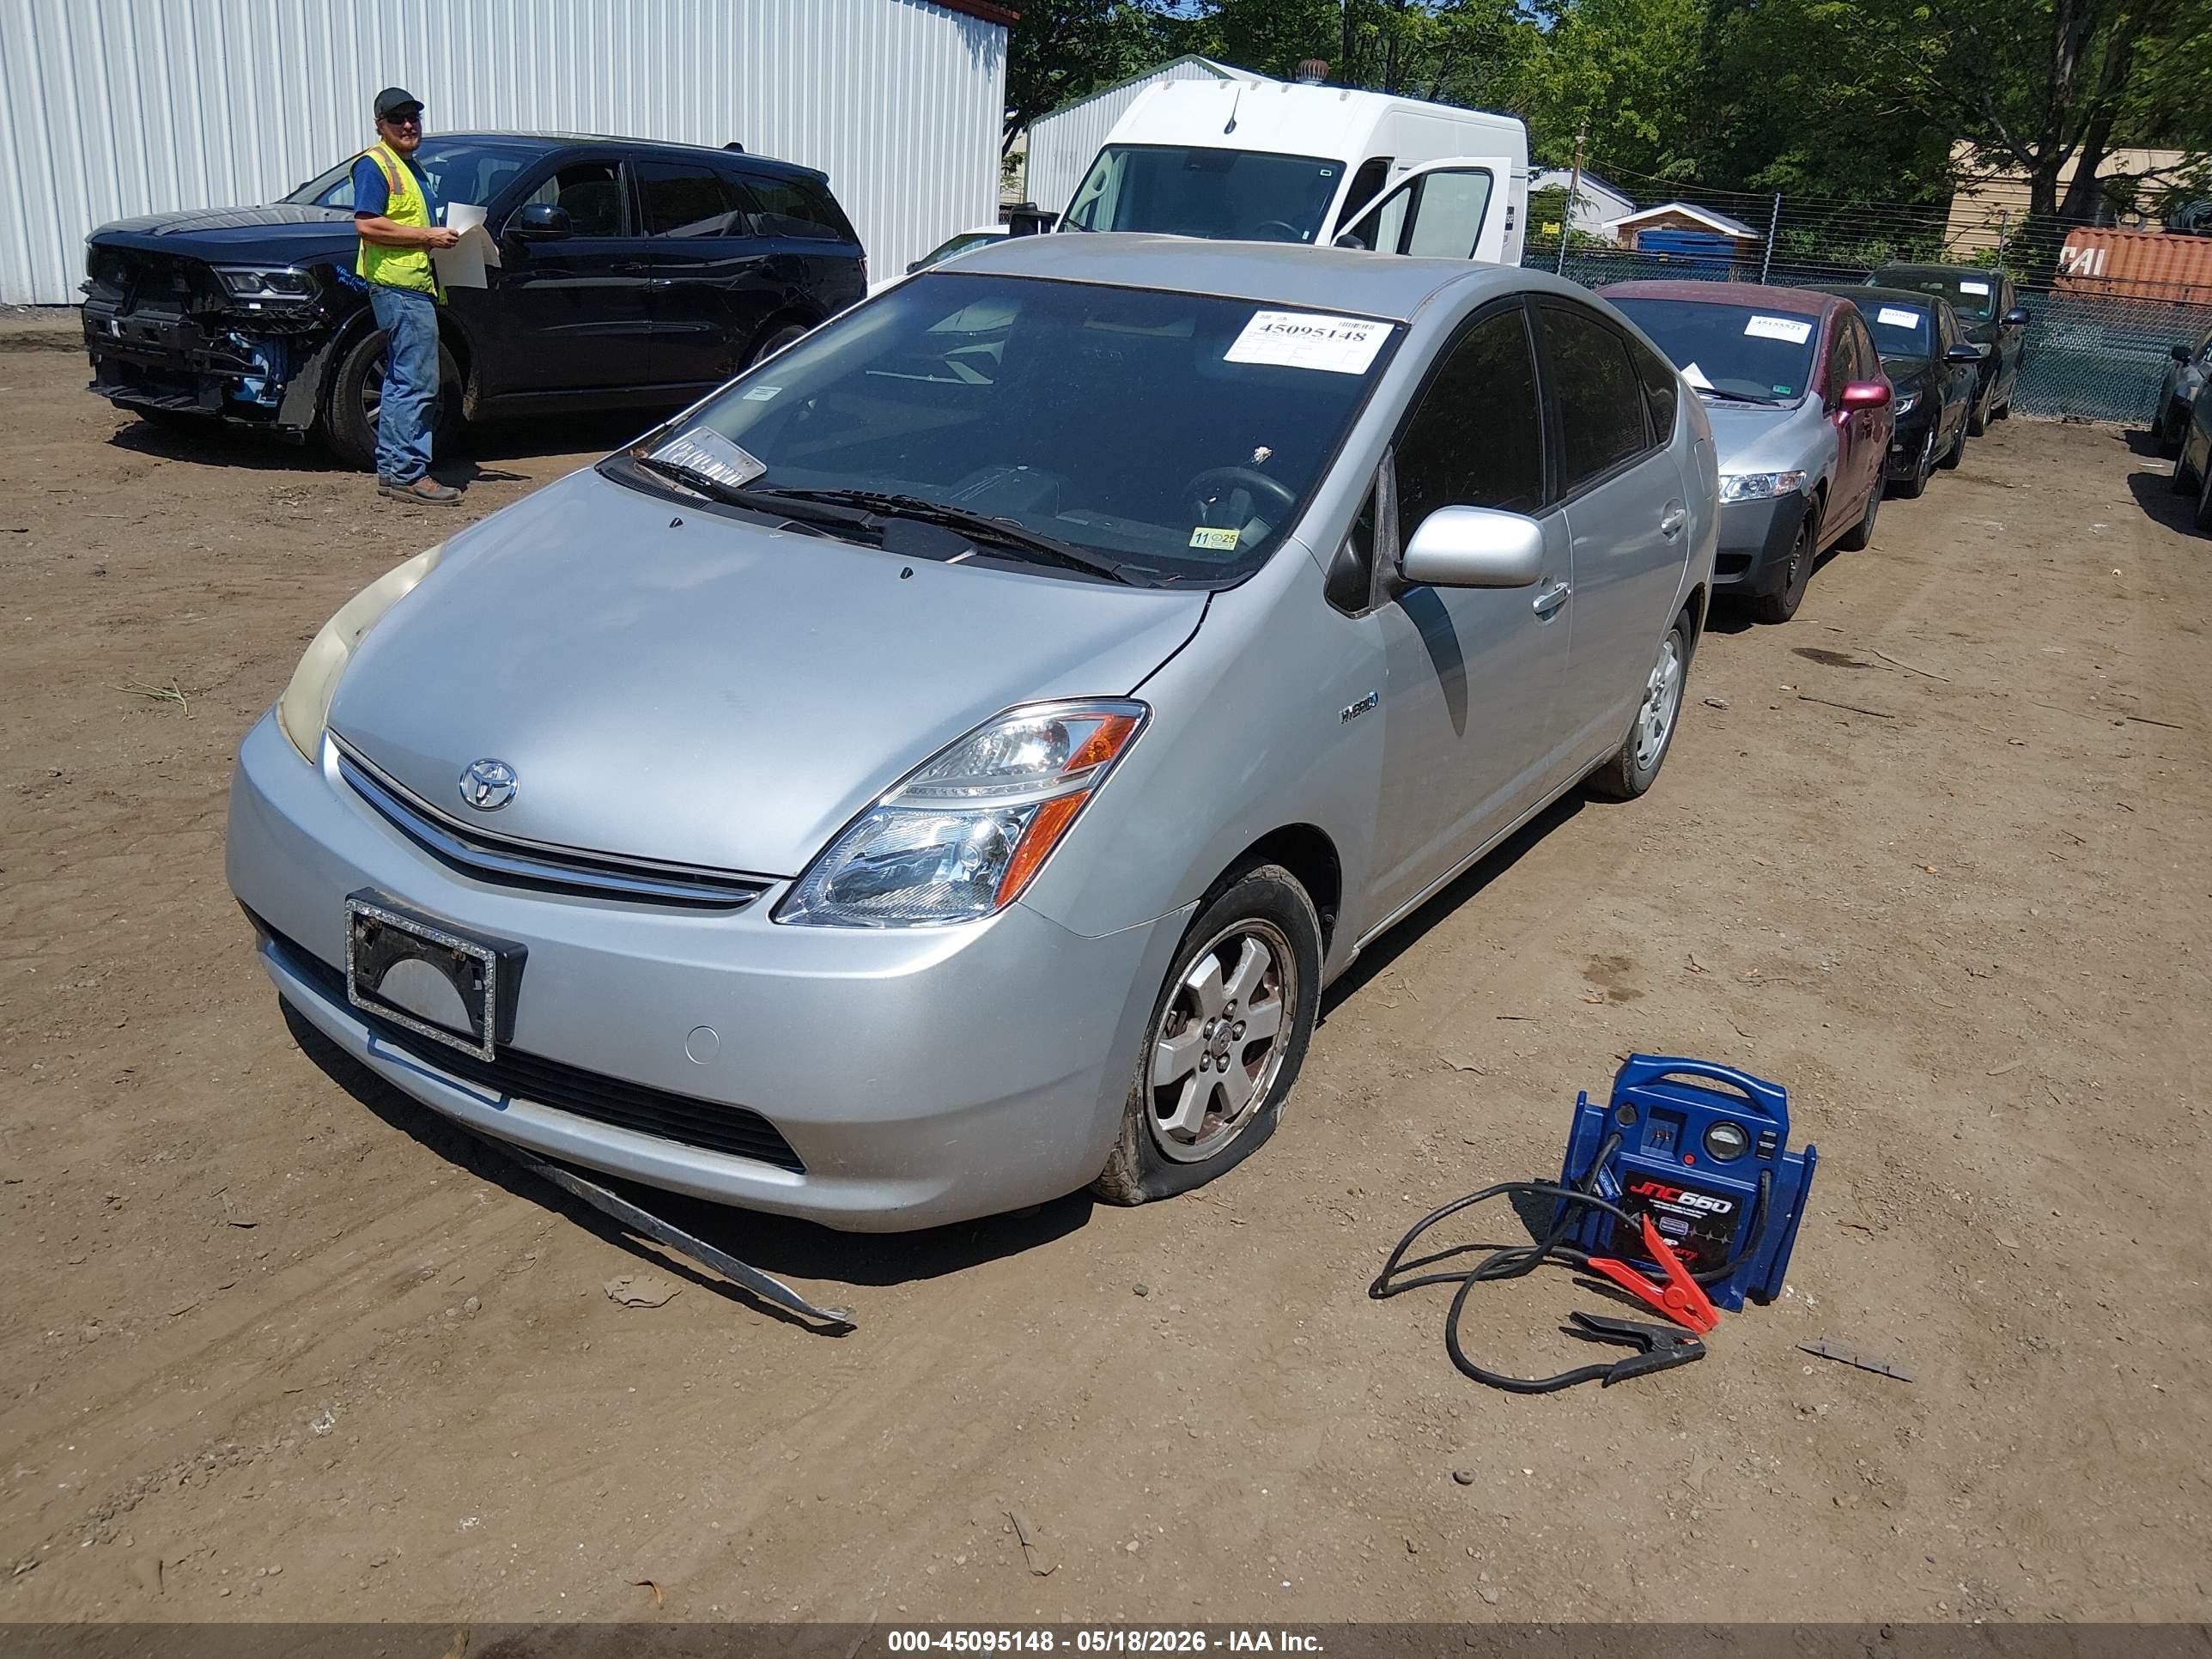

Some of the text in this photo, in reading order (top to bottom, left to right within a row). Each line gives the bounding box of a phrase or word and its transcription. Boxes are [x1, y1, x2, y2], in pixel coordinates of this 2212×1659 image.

[1259, 323, 1367, 342] 45095148
[1196, 532, 1237, 544] 11 25
[1339, 696, 1376, 724] HYBRID
[1630, 1182, 1732, 1213] JNC660
